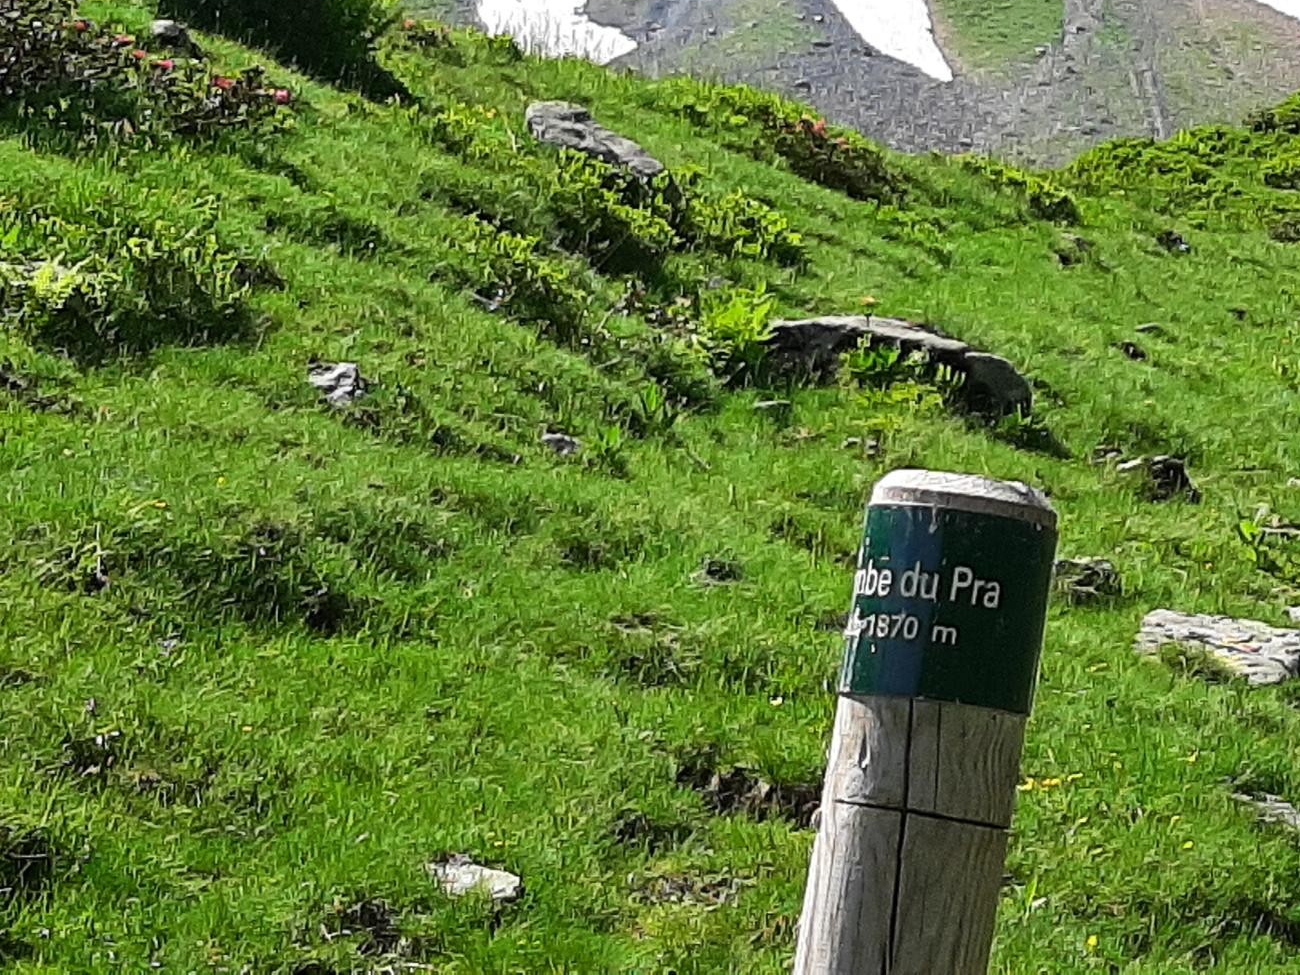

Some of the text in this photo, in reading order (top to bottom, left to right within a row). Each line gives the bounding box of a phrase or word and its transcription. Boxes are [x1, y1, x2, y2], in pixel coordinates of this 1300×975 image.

[901, 560, 940, 601] du
[950, 566, 1001, 608] Pra
[865, 613, 958, 645] 1870 m
